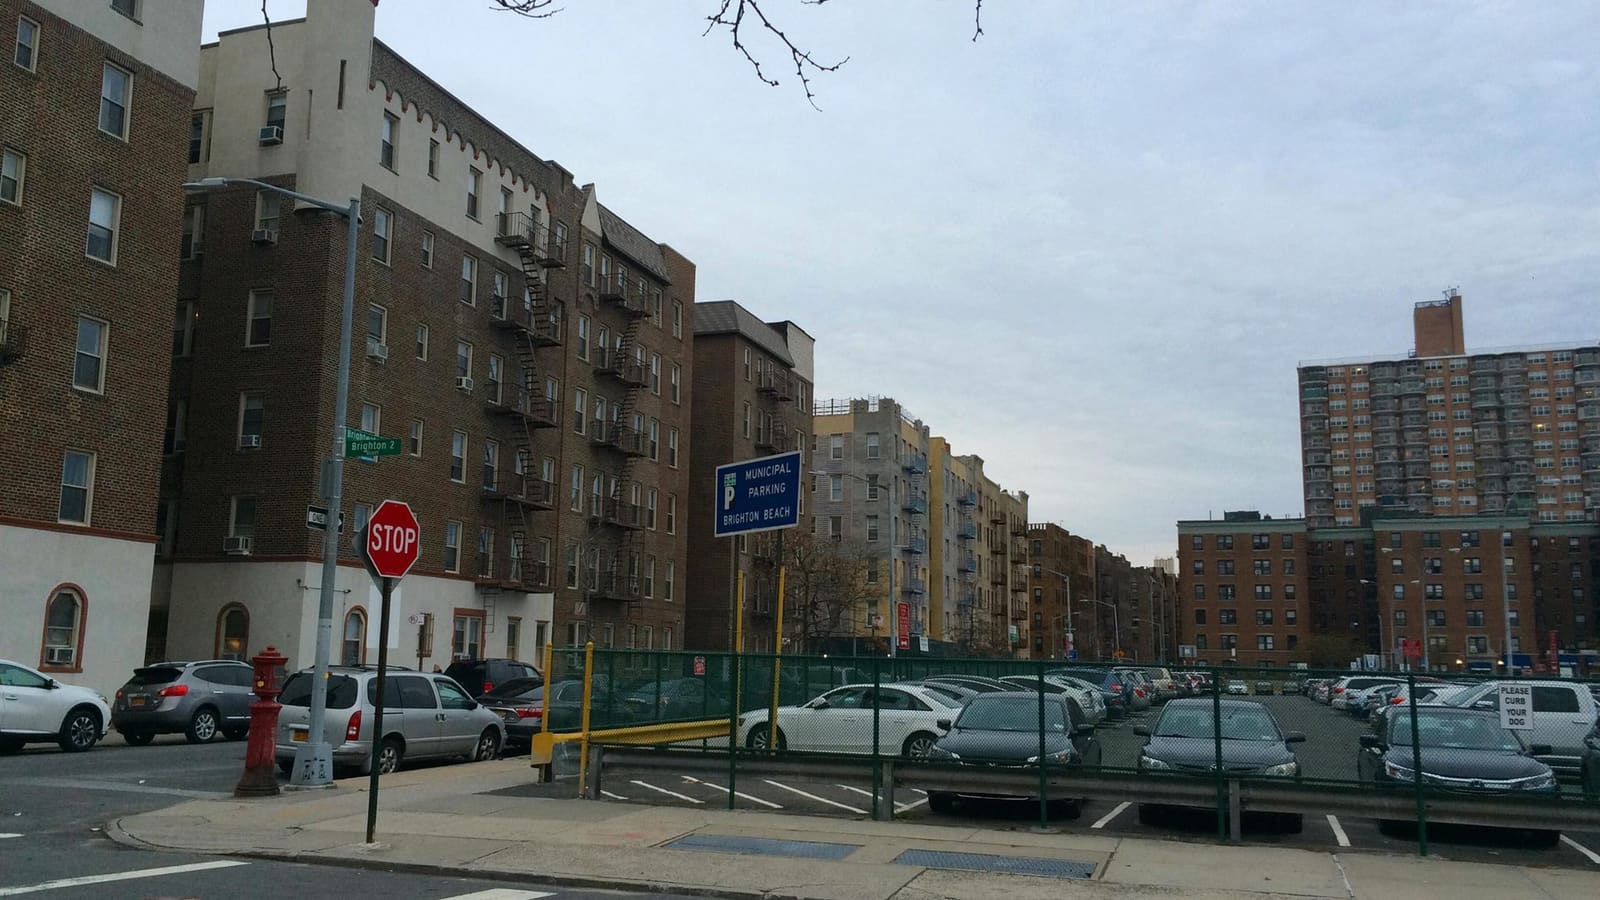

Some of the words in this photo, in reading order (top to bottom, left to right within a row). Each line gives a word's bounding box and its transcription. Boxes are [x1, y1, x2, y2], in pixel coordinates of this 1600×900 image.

[351, 441, 387, 453] Brighton
[389, 440, 395, 449] 2
[745, 463, 791, 480] MUNICIPAL
[724, 486, 735, 510] P
[748, 482, 786, 498] PARKING
[723, 511, 759, 526] BRIGHTON
[763, 506, 790, 521] BEACH
[371, 523, 416, 554] STOP
[1501, 687, 1529, 695] PLEASE
